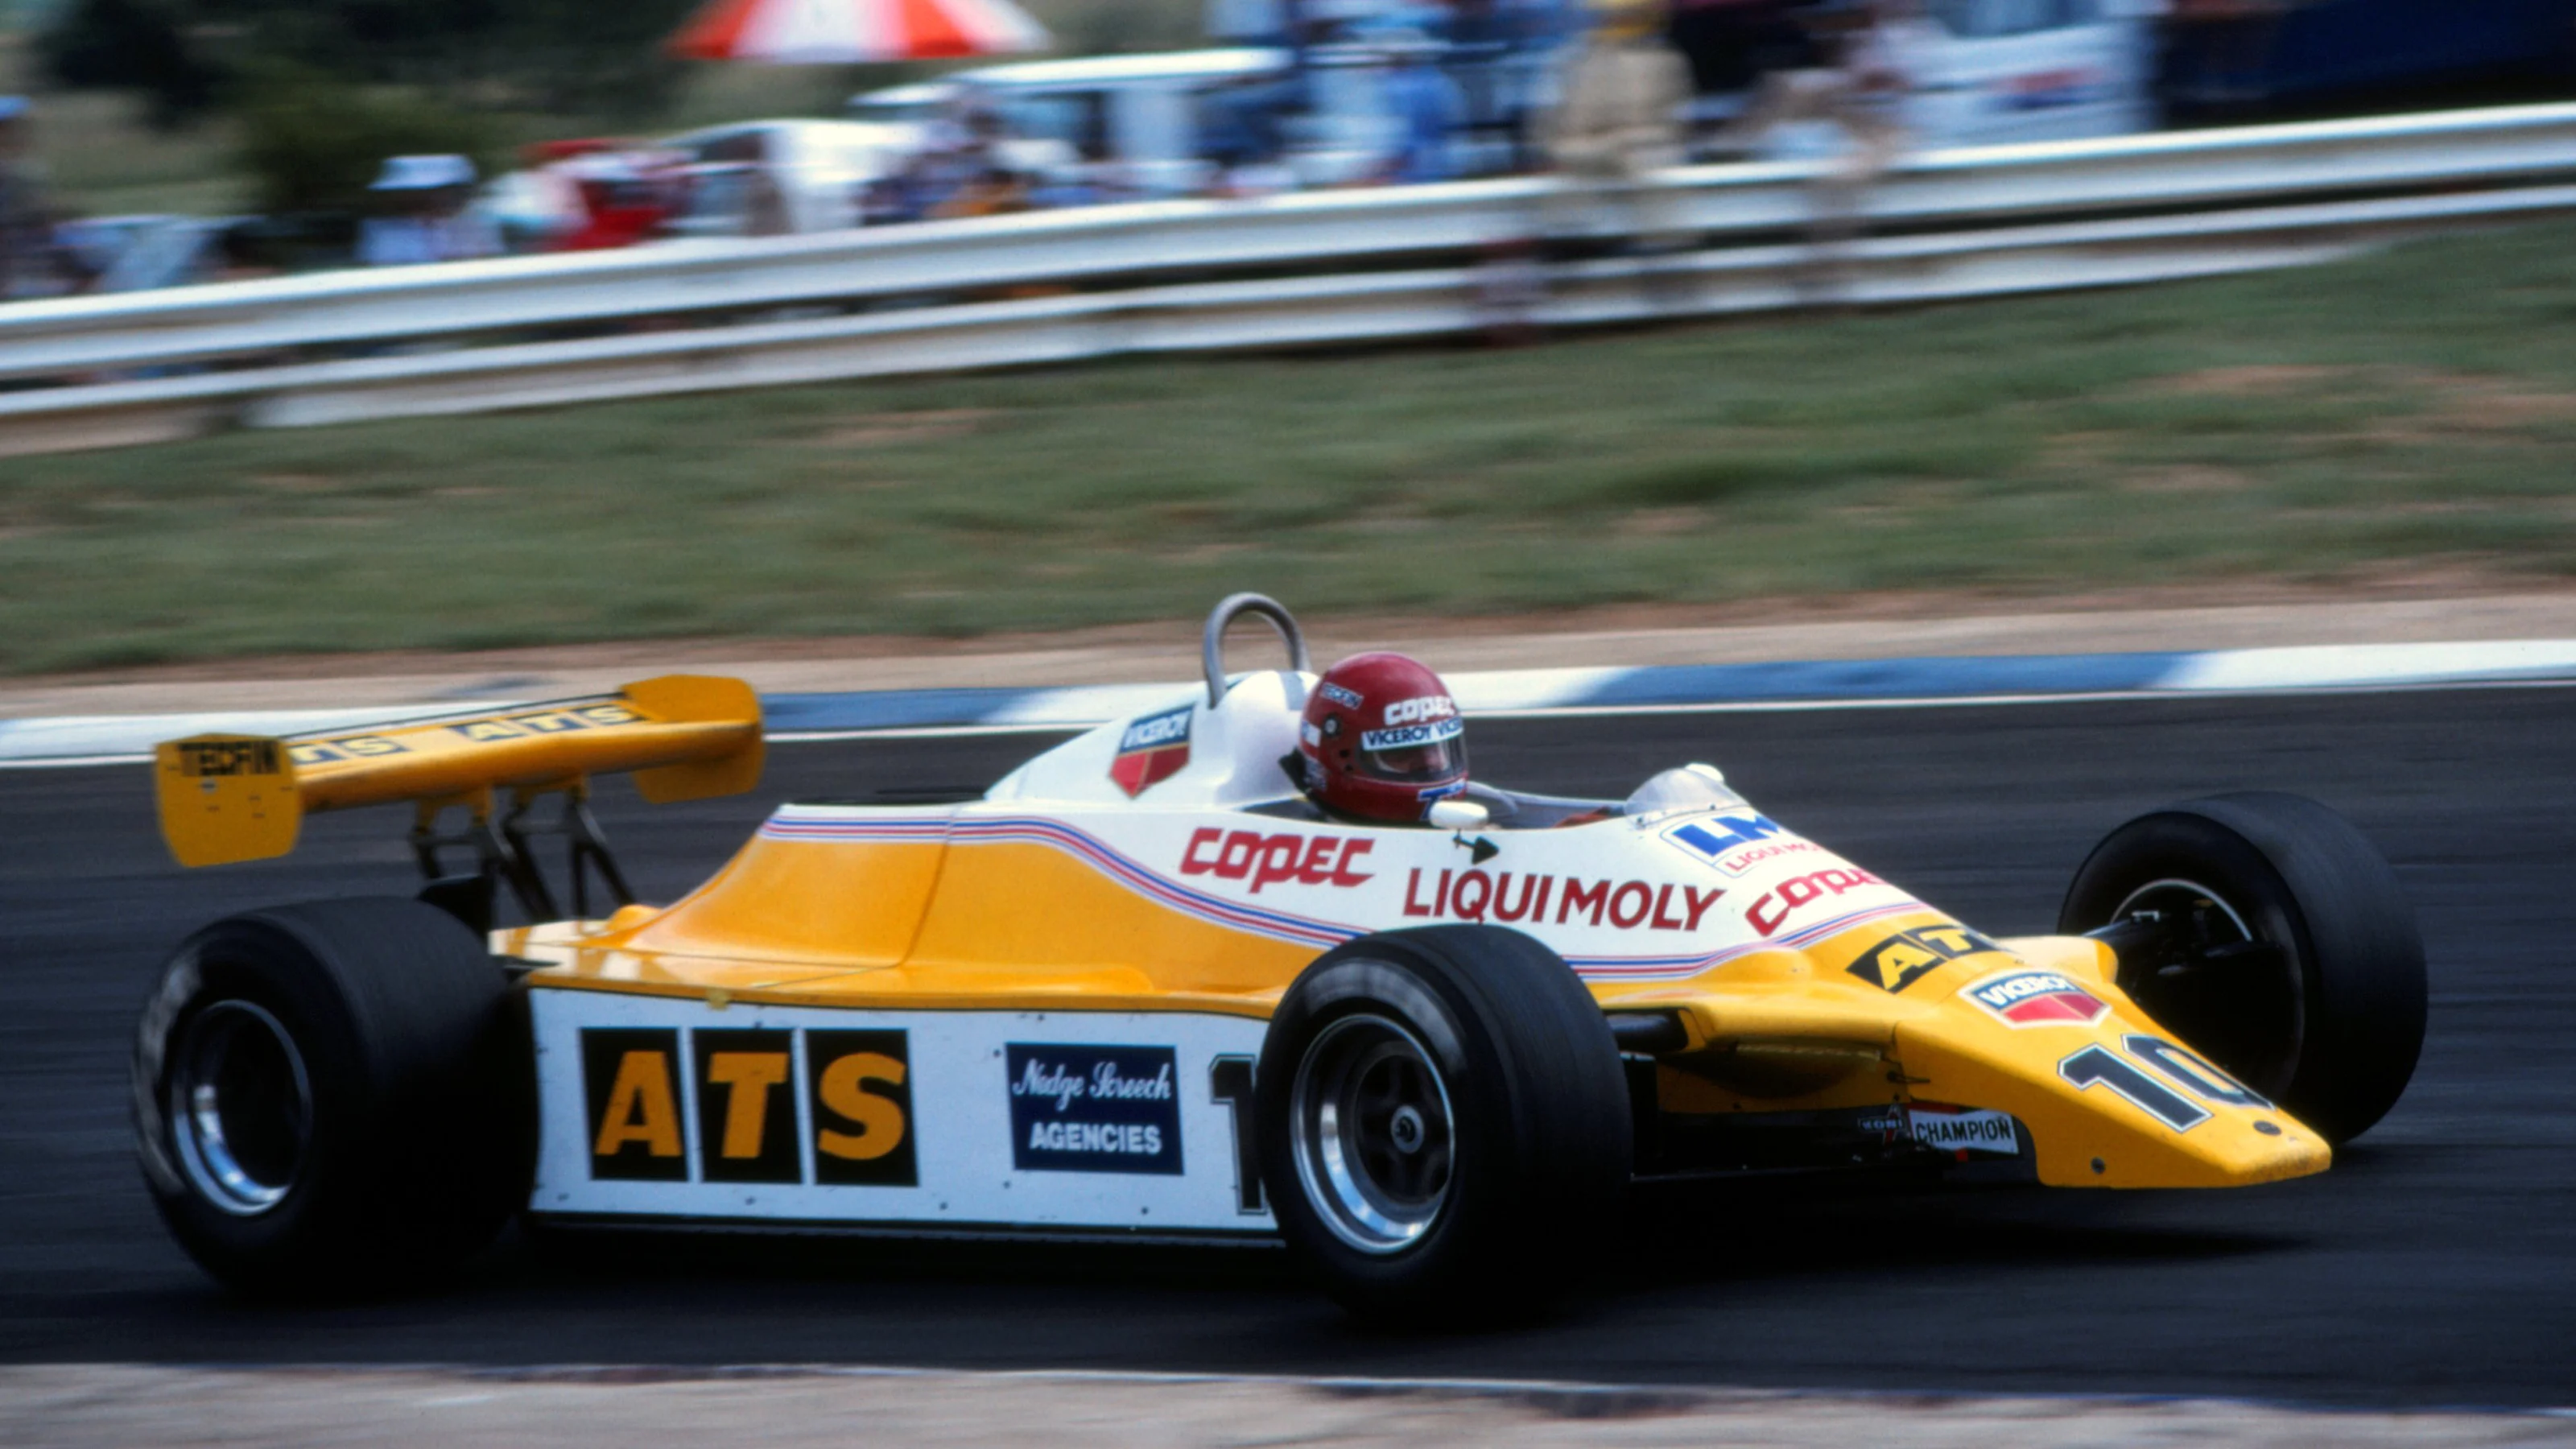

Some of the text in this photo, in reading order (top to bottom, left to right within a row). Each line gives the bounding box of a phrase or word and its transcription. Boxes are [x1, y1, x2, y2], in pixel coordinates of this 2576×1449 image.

[287, 704, 639, 764] TS ATS
[1124, 709, 1192, 749] VICEROY
[1367, 725, 1433, 746] VICEROY
[1402, 867, 1728, 932] LIQUI MOLY
[1978, 973, 2078, 1006] VICEROY
[1088, 1061, 1172, 1100] Screech
[2056, 1034, 2278, 1133] 10
[593, 1050, 907, 1161] ATS
[1029, 1121, 1163, 1155] AGENCIES
[1915, 1117, 2012, 1143] CHAMPION
